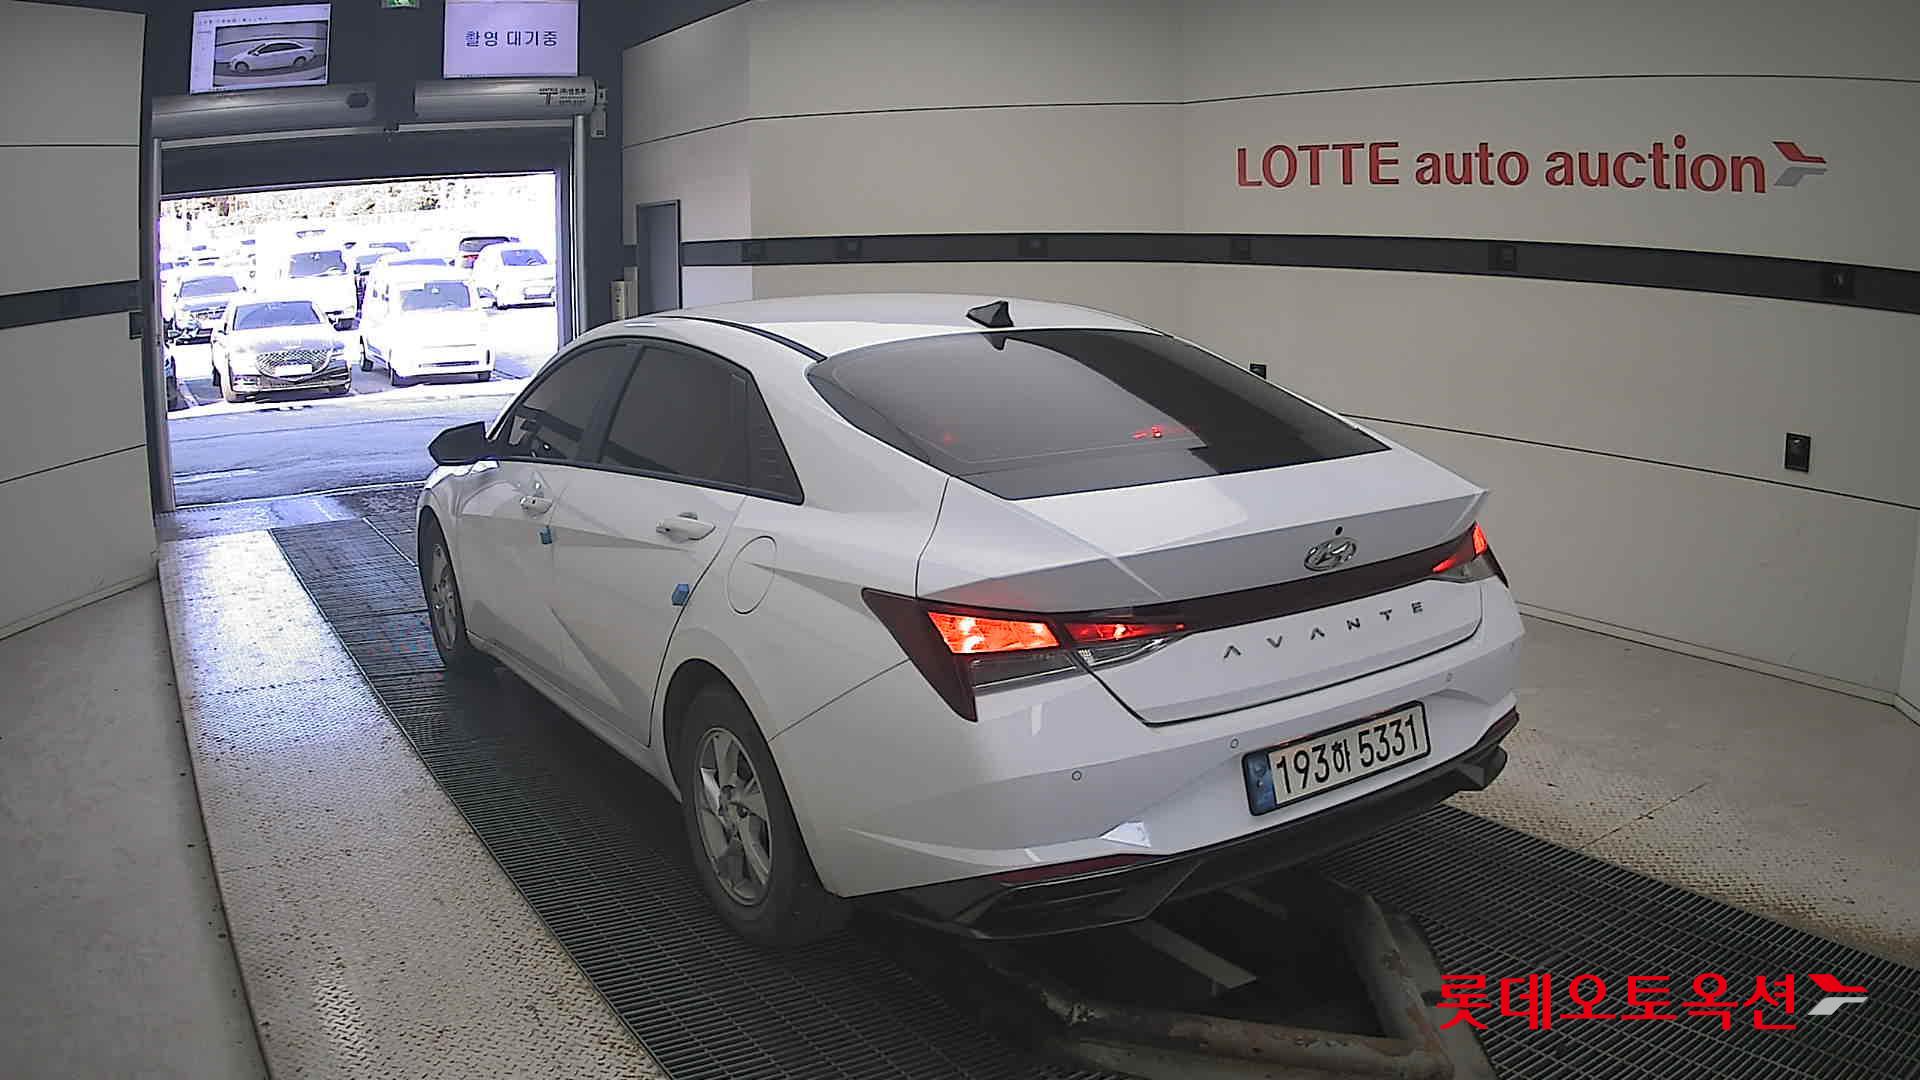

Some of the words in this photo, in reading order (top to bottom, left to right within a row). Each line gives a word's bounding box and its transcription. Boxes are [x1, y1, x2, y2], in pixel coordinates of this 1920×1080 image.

[506, 30, 558, 47] 대기중
[1238, 141, 1398, 188] LOTTE
[1415, 144, 1529, 186] auto
[1545, 135, 1767, 193] auction
[1223, 601, 1424, 659] AVANTE
[1276, 738, 1352, 794] 193하
[1357, 714, 1419, 768] 5331
